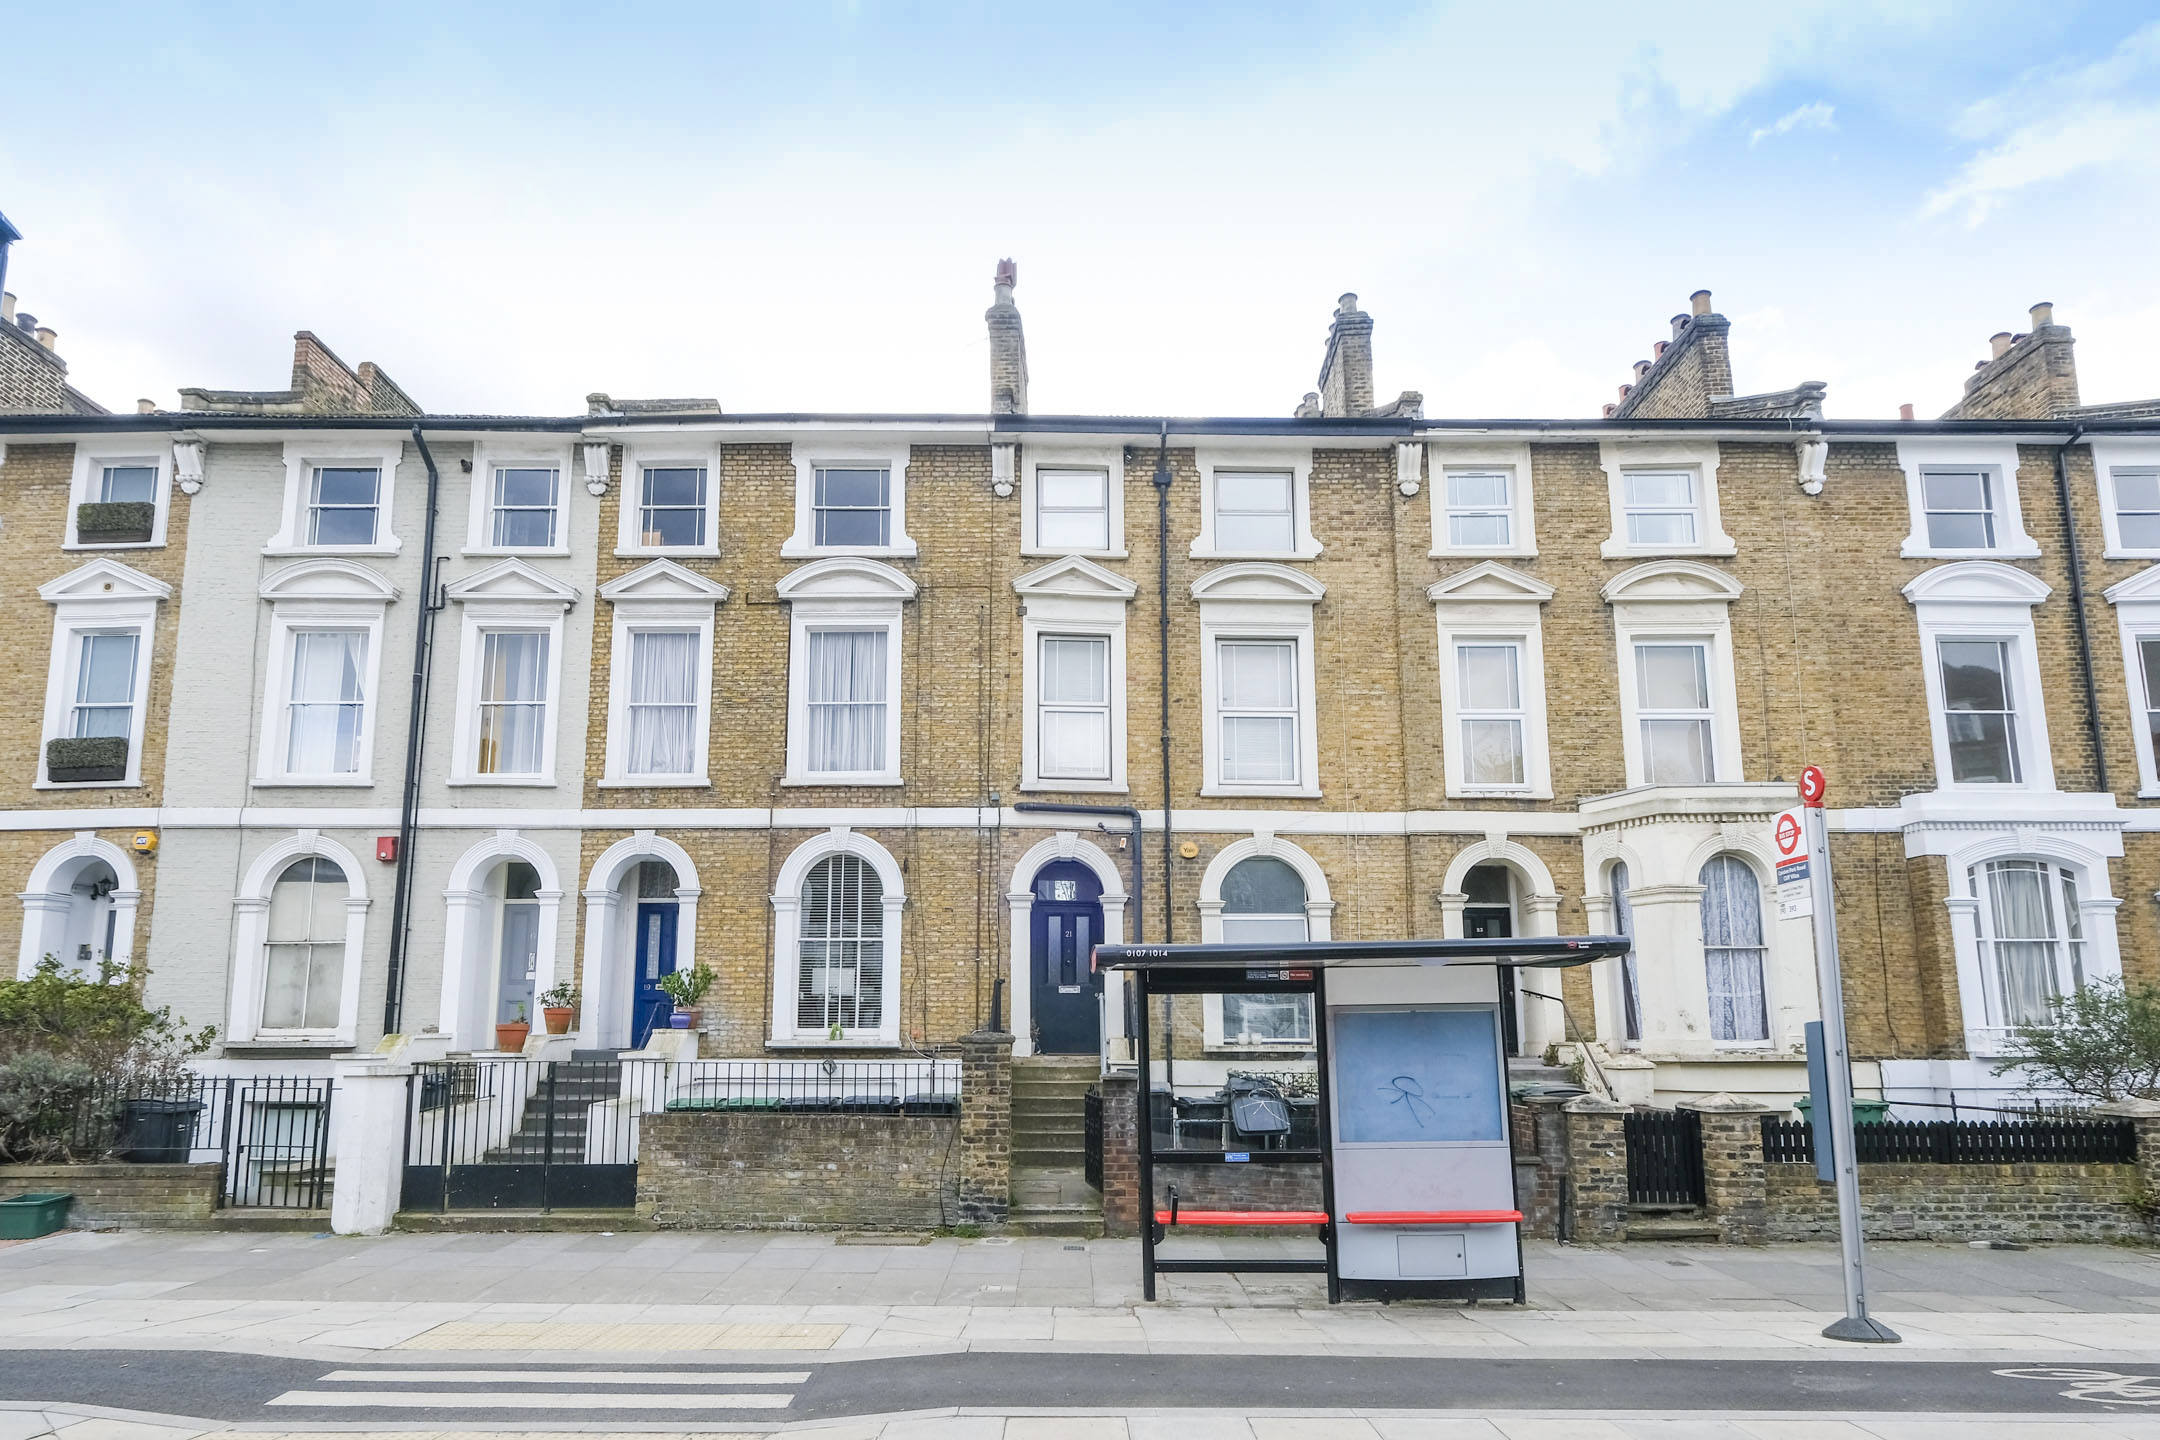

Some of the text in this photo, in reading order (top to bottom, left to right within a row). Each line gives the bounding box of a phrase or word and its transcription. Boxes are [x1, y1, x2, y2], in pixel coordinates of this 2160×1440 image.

[1804, 770, 1816, 796] S
[1065, 930, 1072, 938] 21
[1126, 949, 1169, 957] 0107 1014
